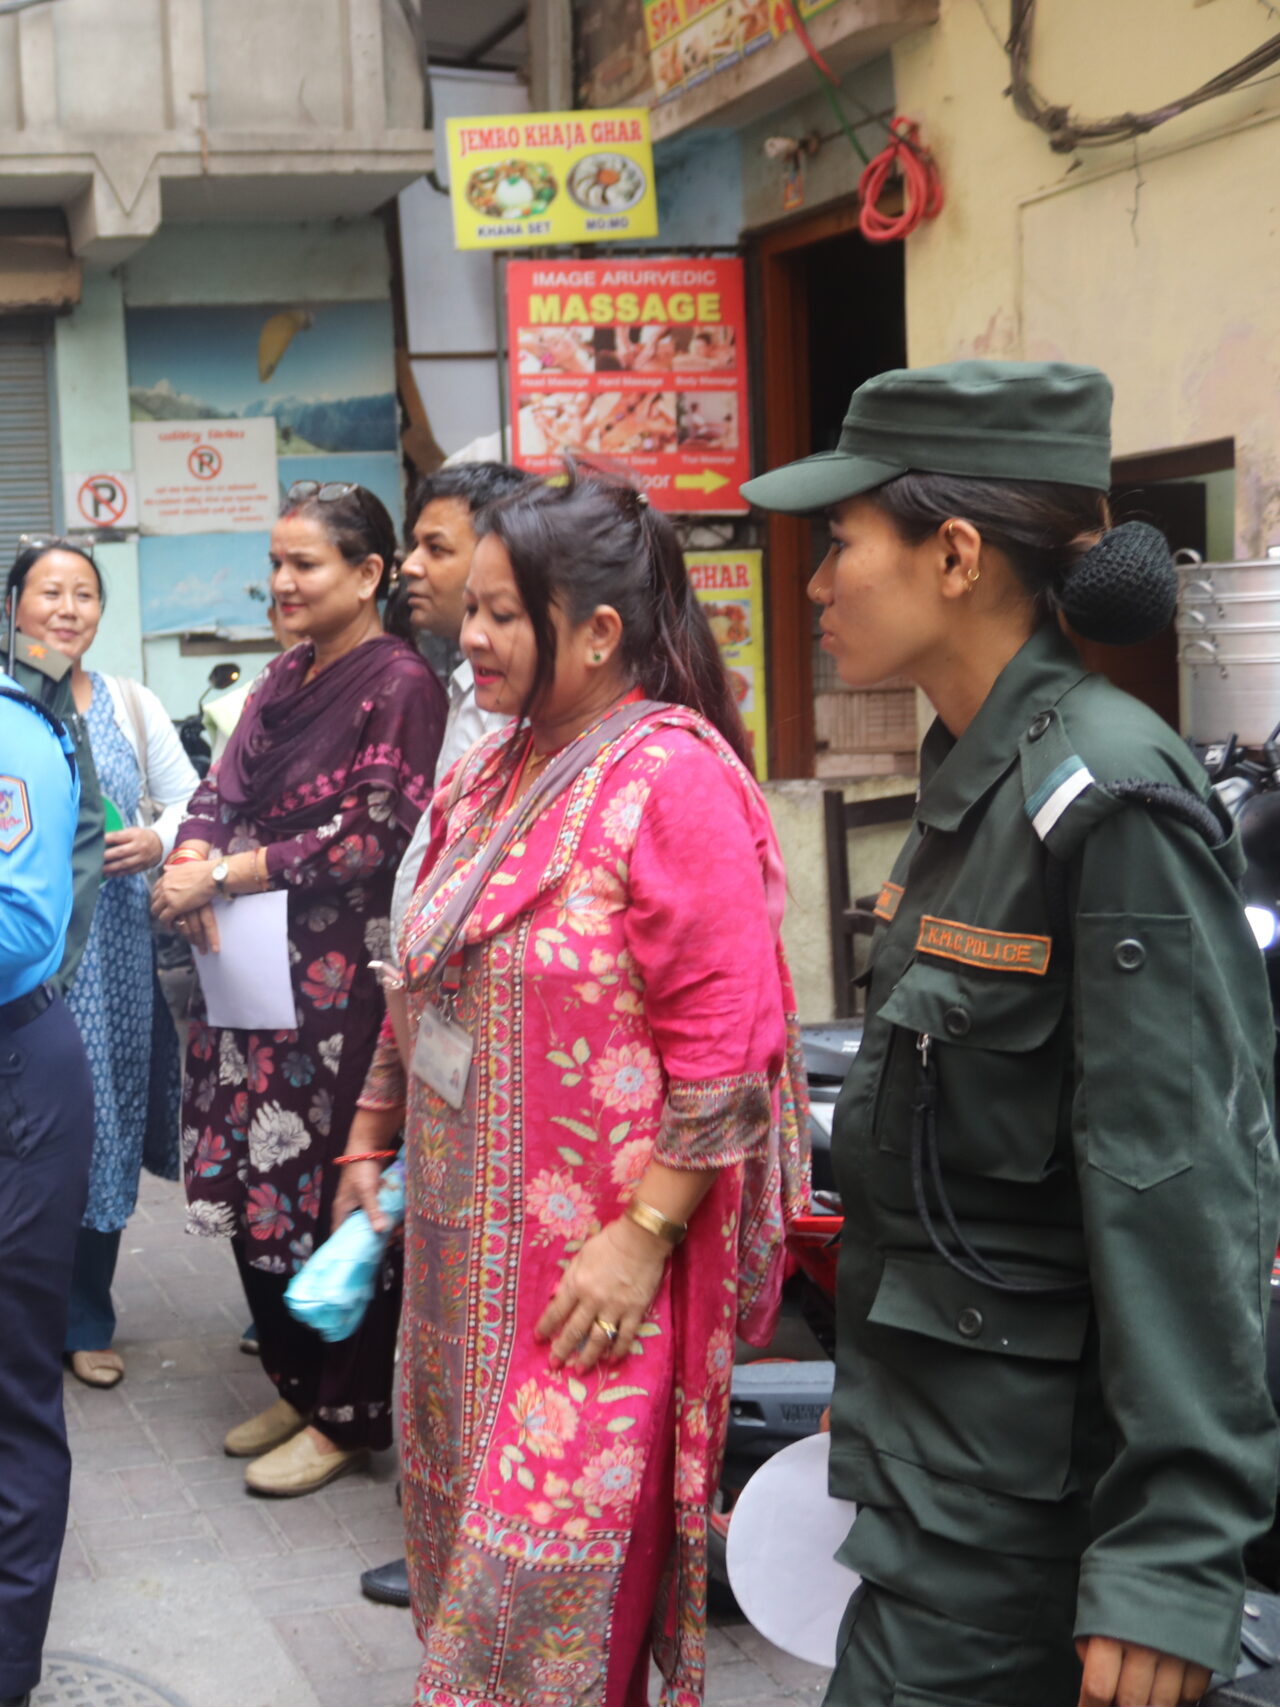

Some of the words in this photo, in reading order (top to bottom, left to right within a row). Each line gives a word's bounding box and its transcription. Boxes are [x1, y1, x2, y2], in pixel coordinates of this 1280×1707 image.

[525, 121, 587, 150] KHAJA
[591, 119, 643, 144] GHAR
[478, 223, 523, 238] KHANA
[528, 221, 551, 234] SET
[532, 270, 596, 287] IMAGE
[601, 268, 717, 286] ARURVEDIC
[528, 291, 722, 324] MASSAGE
[688, 563, 750, 590] GHAR
[964, 936, 1034, 963] POLICE
